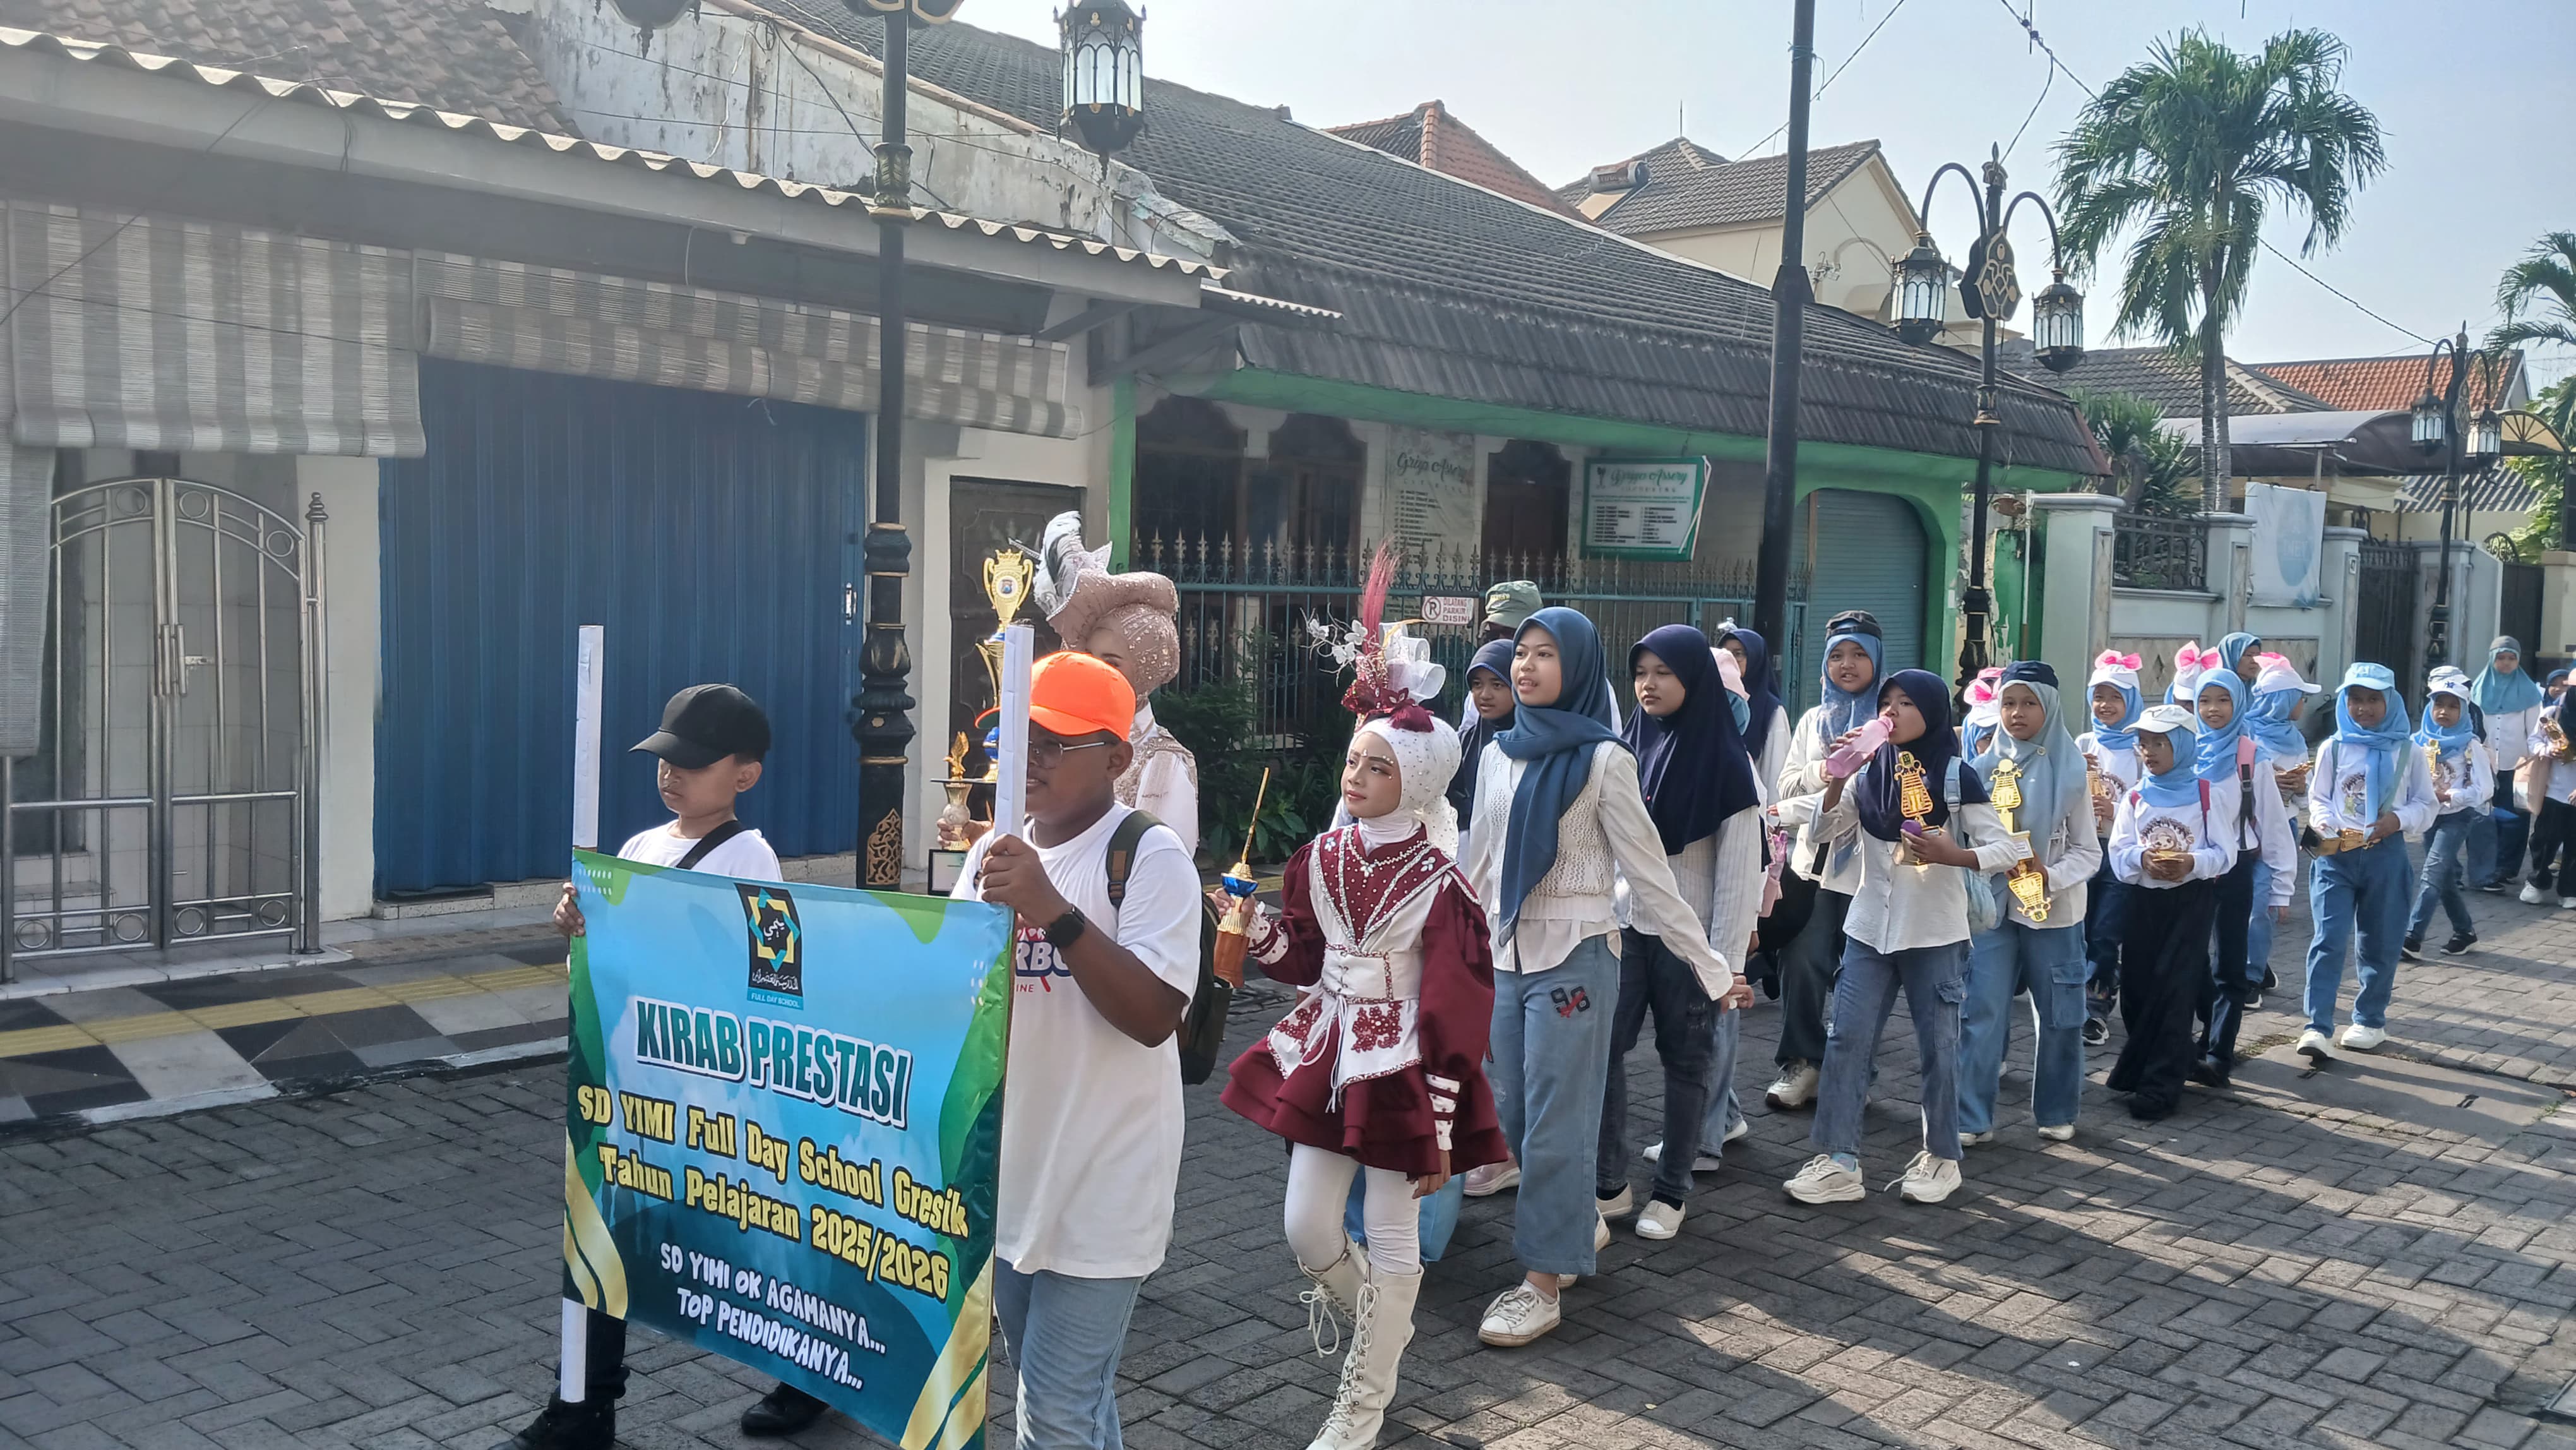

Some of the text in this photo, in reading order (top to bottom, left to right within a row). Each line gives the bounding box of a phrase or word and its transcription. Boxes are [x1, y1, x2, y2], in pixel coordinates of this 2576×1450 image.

[751, 992, 800, 1008] FULL DAY SCHOOL
[635, 998, 910, 1125] KIRAB PRESTASI
[577, 1084, 969, 1239] SD YIMI Full Day School Gresik
[598, 1144, 948, 1300] Tahun Pelajaran 2025/2026
[660, 1242, 886, 1355] SD YIMI OK AGAMANYA...
[676, 1287, 864, 1390] TOP PENDIDIKANYA...
